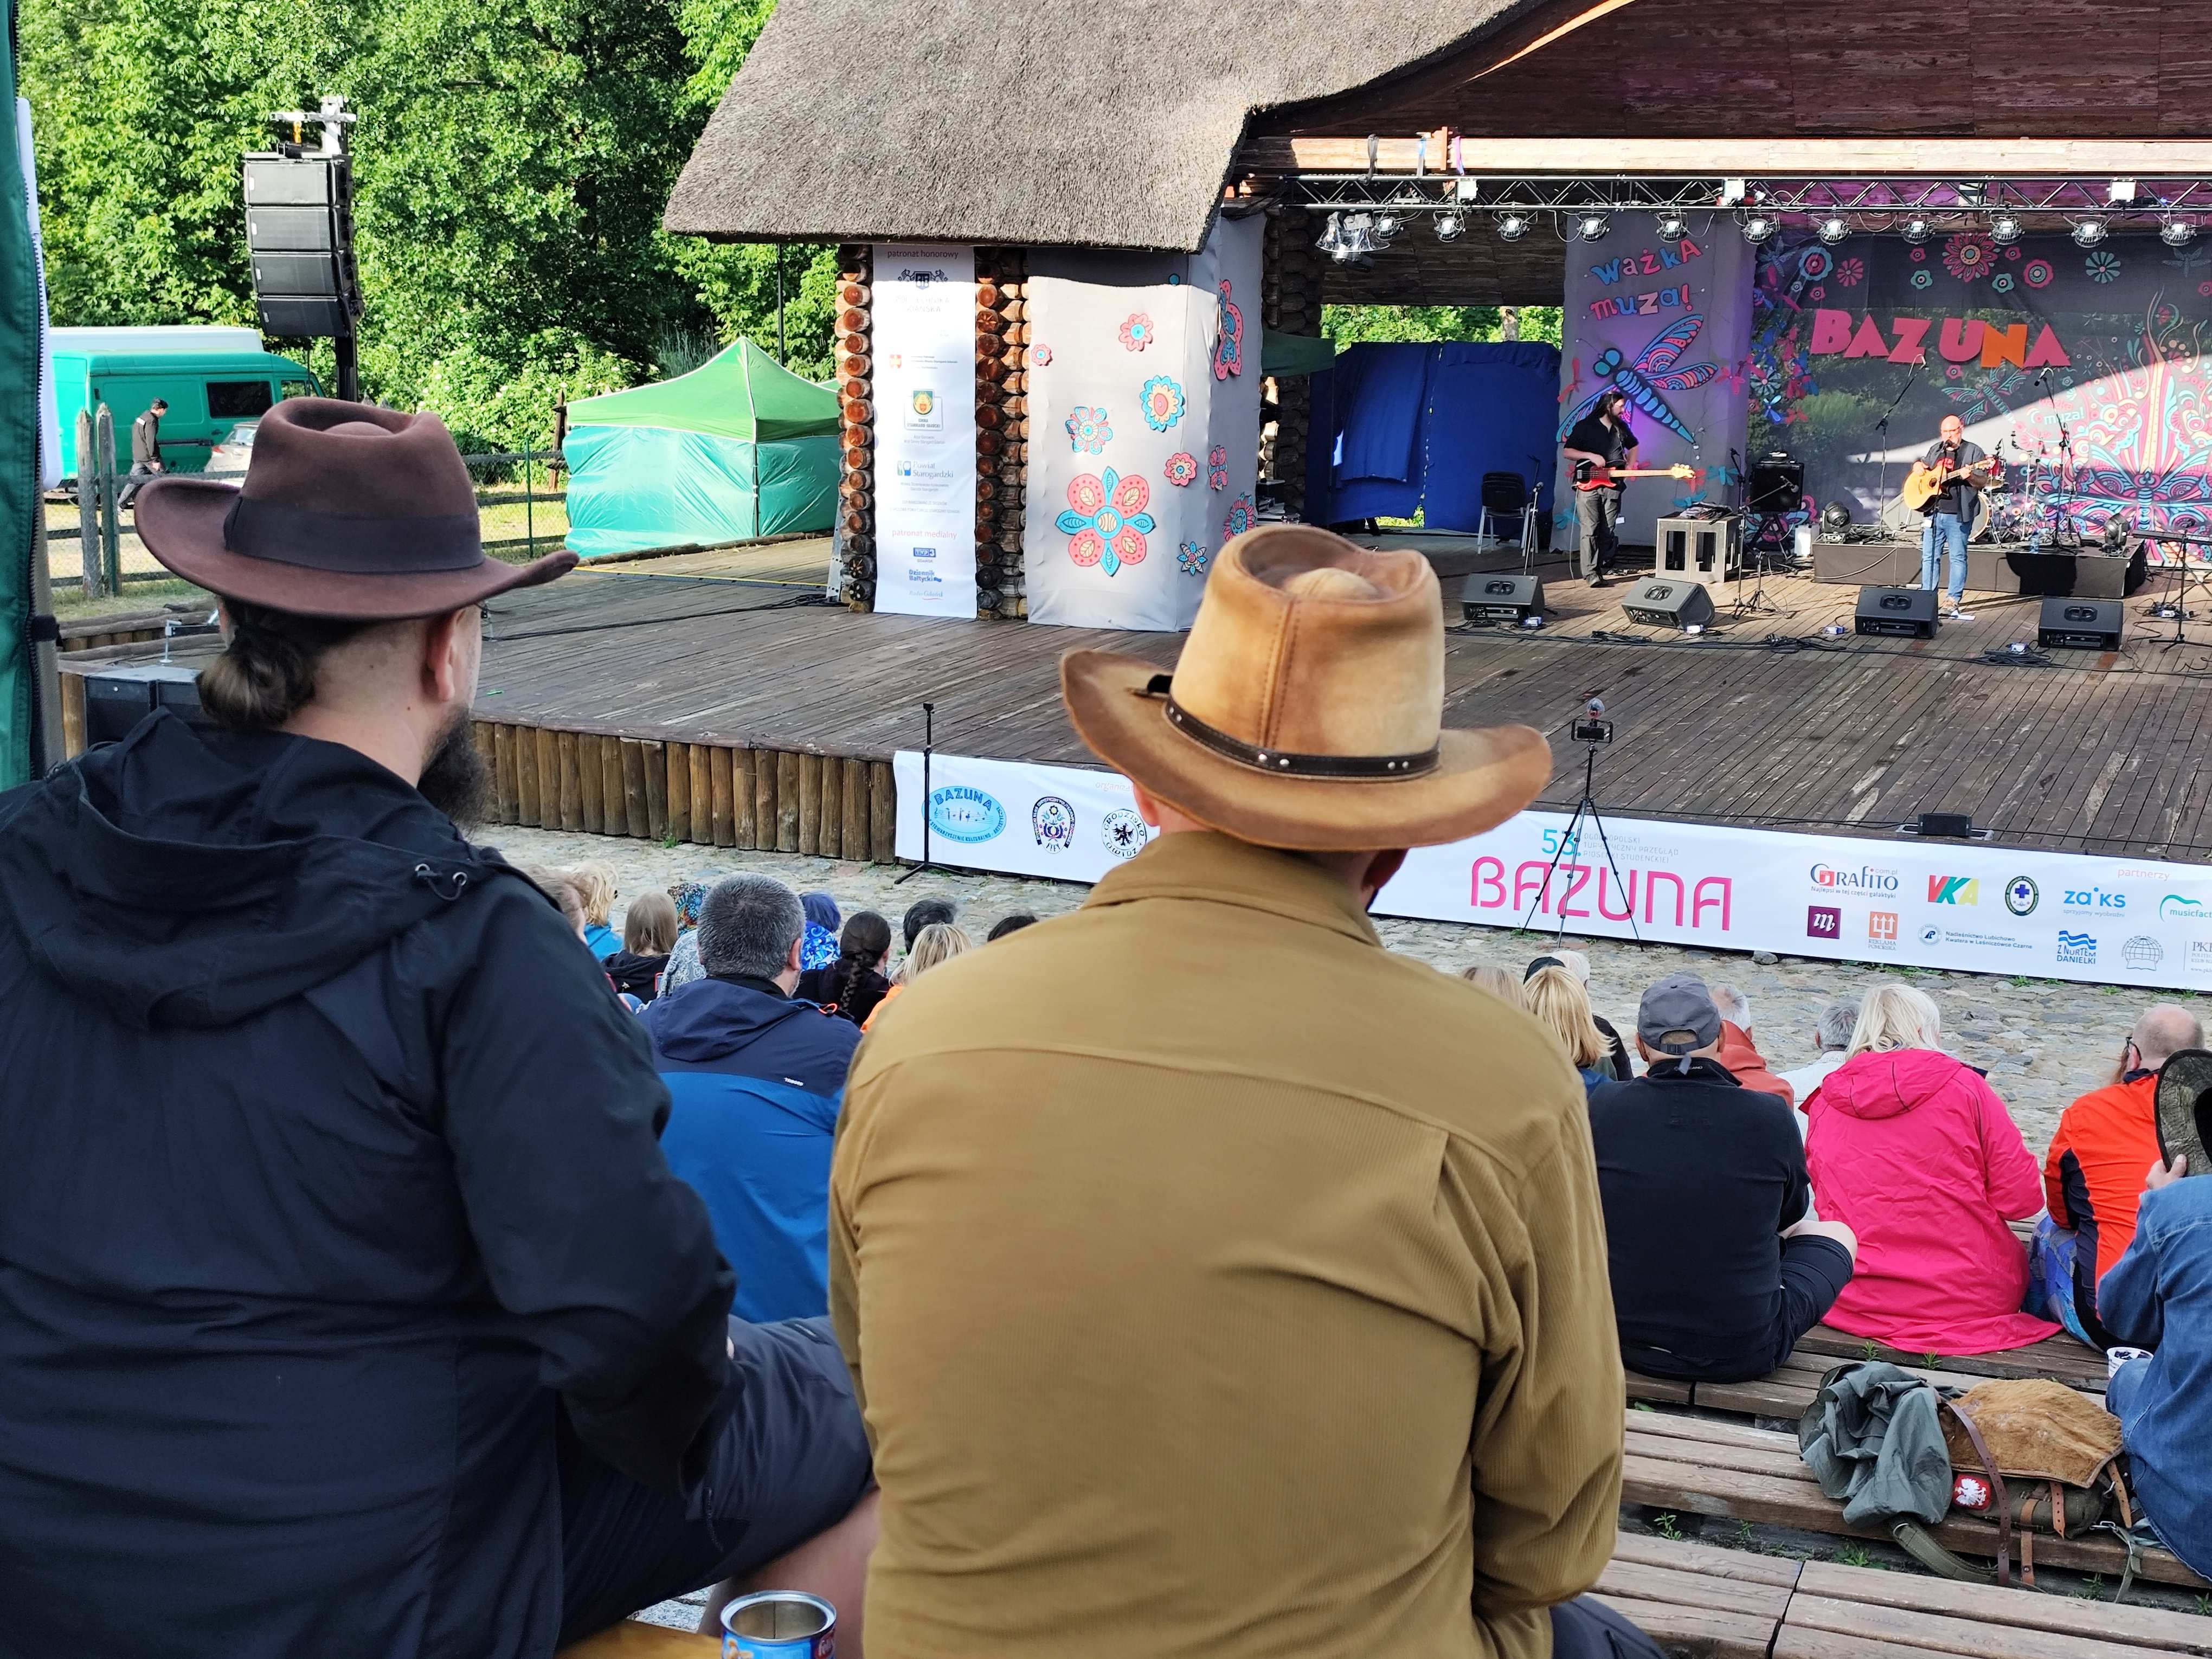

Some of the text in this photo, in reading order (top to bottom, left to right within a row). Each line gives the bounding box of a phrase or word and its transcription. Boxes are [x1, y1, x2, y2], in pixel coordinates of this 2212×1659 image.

[921, 250, 959, 259] honorowy
[1810, 309, 2072, 368] BAZUNA
[913, 460, 935, 469] Powiat
[912, 470, 954, 479] Starogardzki
[924, 530, 957, 540] medialny
[909, 575, 933, 583] Bałtycki
[1095, 781, 1132, 792] organiza
[934, 788, 992, 811] BAZUNA
[1584, 833, 1640, 844] OGÓLOPOLSKI
[1583, 850, 1618, 860] PIOSEKI
[2117, 868, 2170, 881] partnerzy
[1471, 856, 1732, 931] BAZUNA
[1928, 875, 1979, 906] VKA
[2057, 955, 2096, 964] DANIELKI
